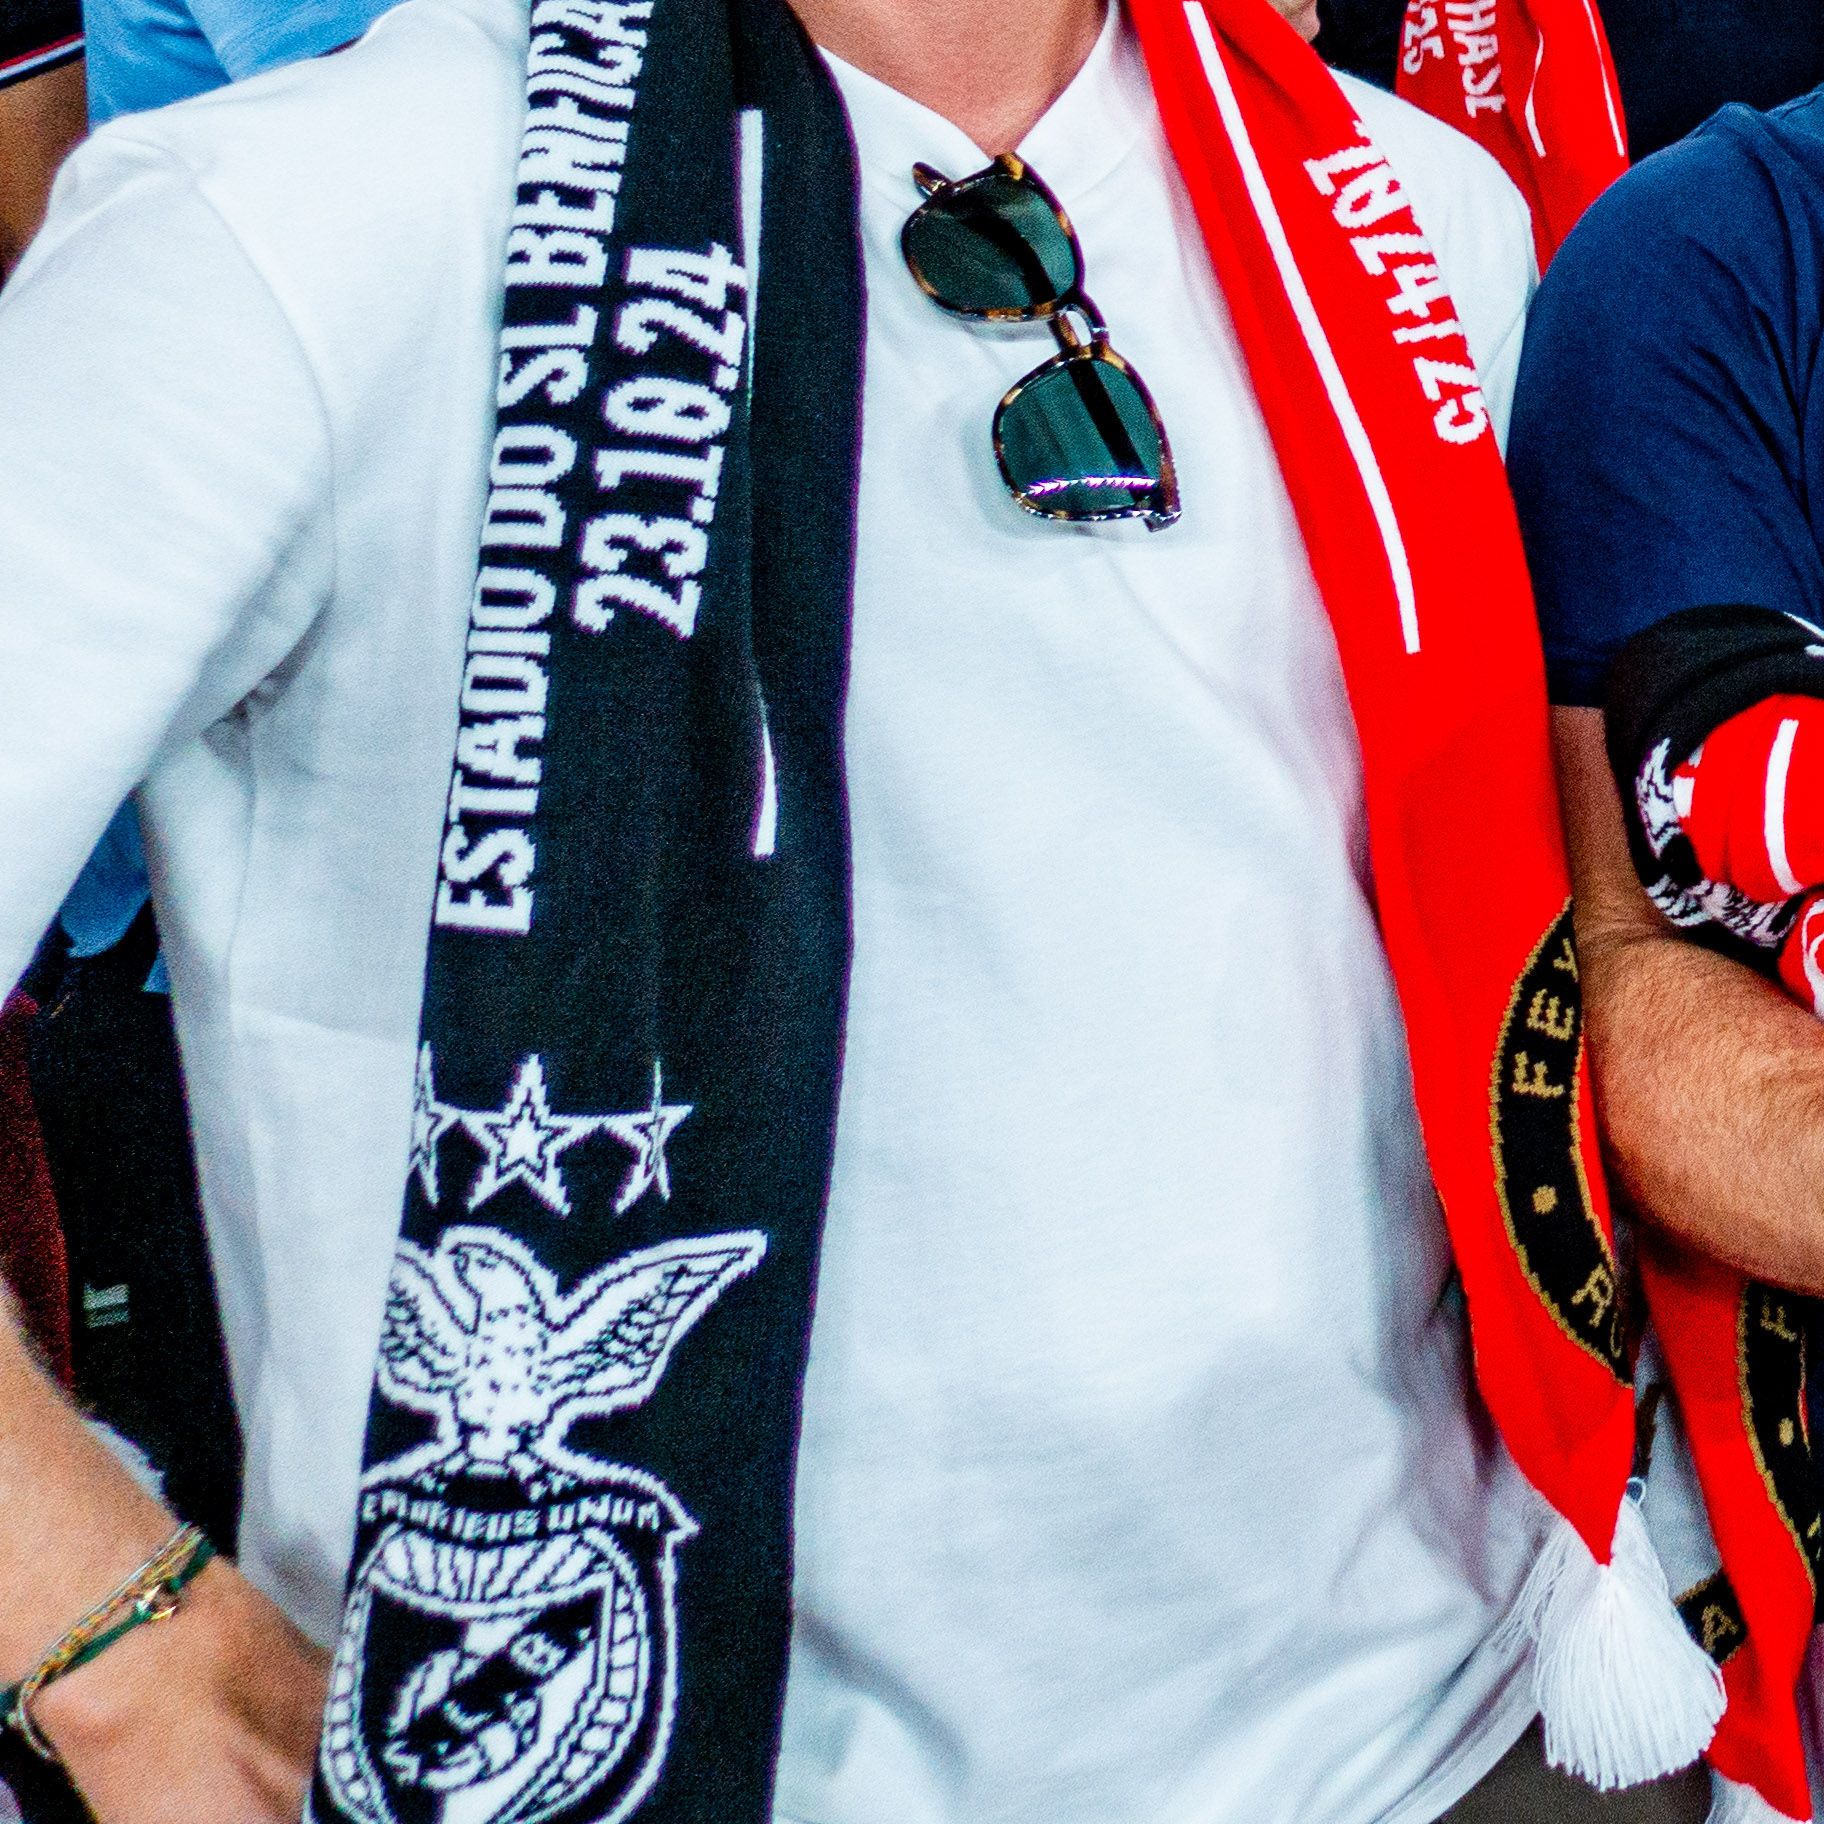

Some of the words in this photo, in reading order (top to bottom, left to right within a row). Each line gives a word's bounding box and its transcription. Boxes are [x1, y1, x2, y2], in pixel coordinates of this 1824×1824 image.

[498, 301, 599, 407] SL
[568, 242, 746, 639] 23.10.24
[479, 422, 580, 553] DO
[434, 556, 561, 934] ESTADIO
